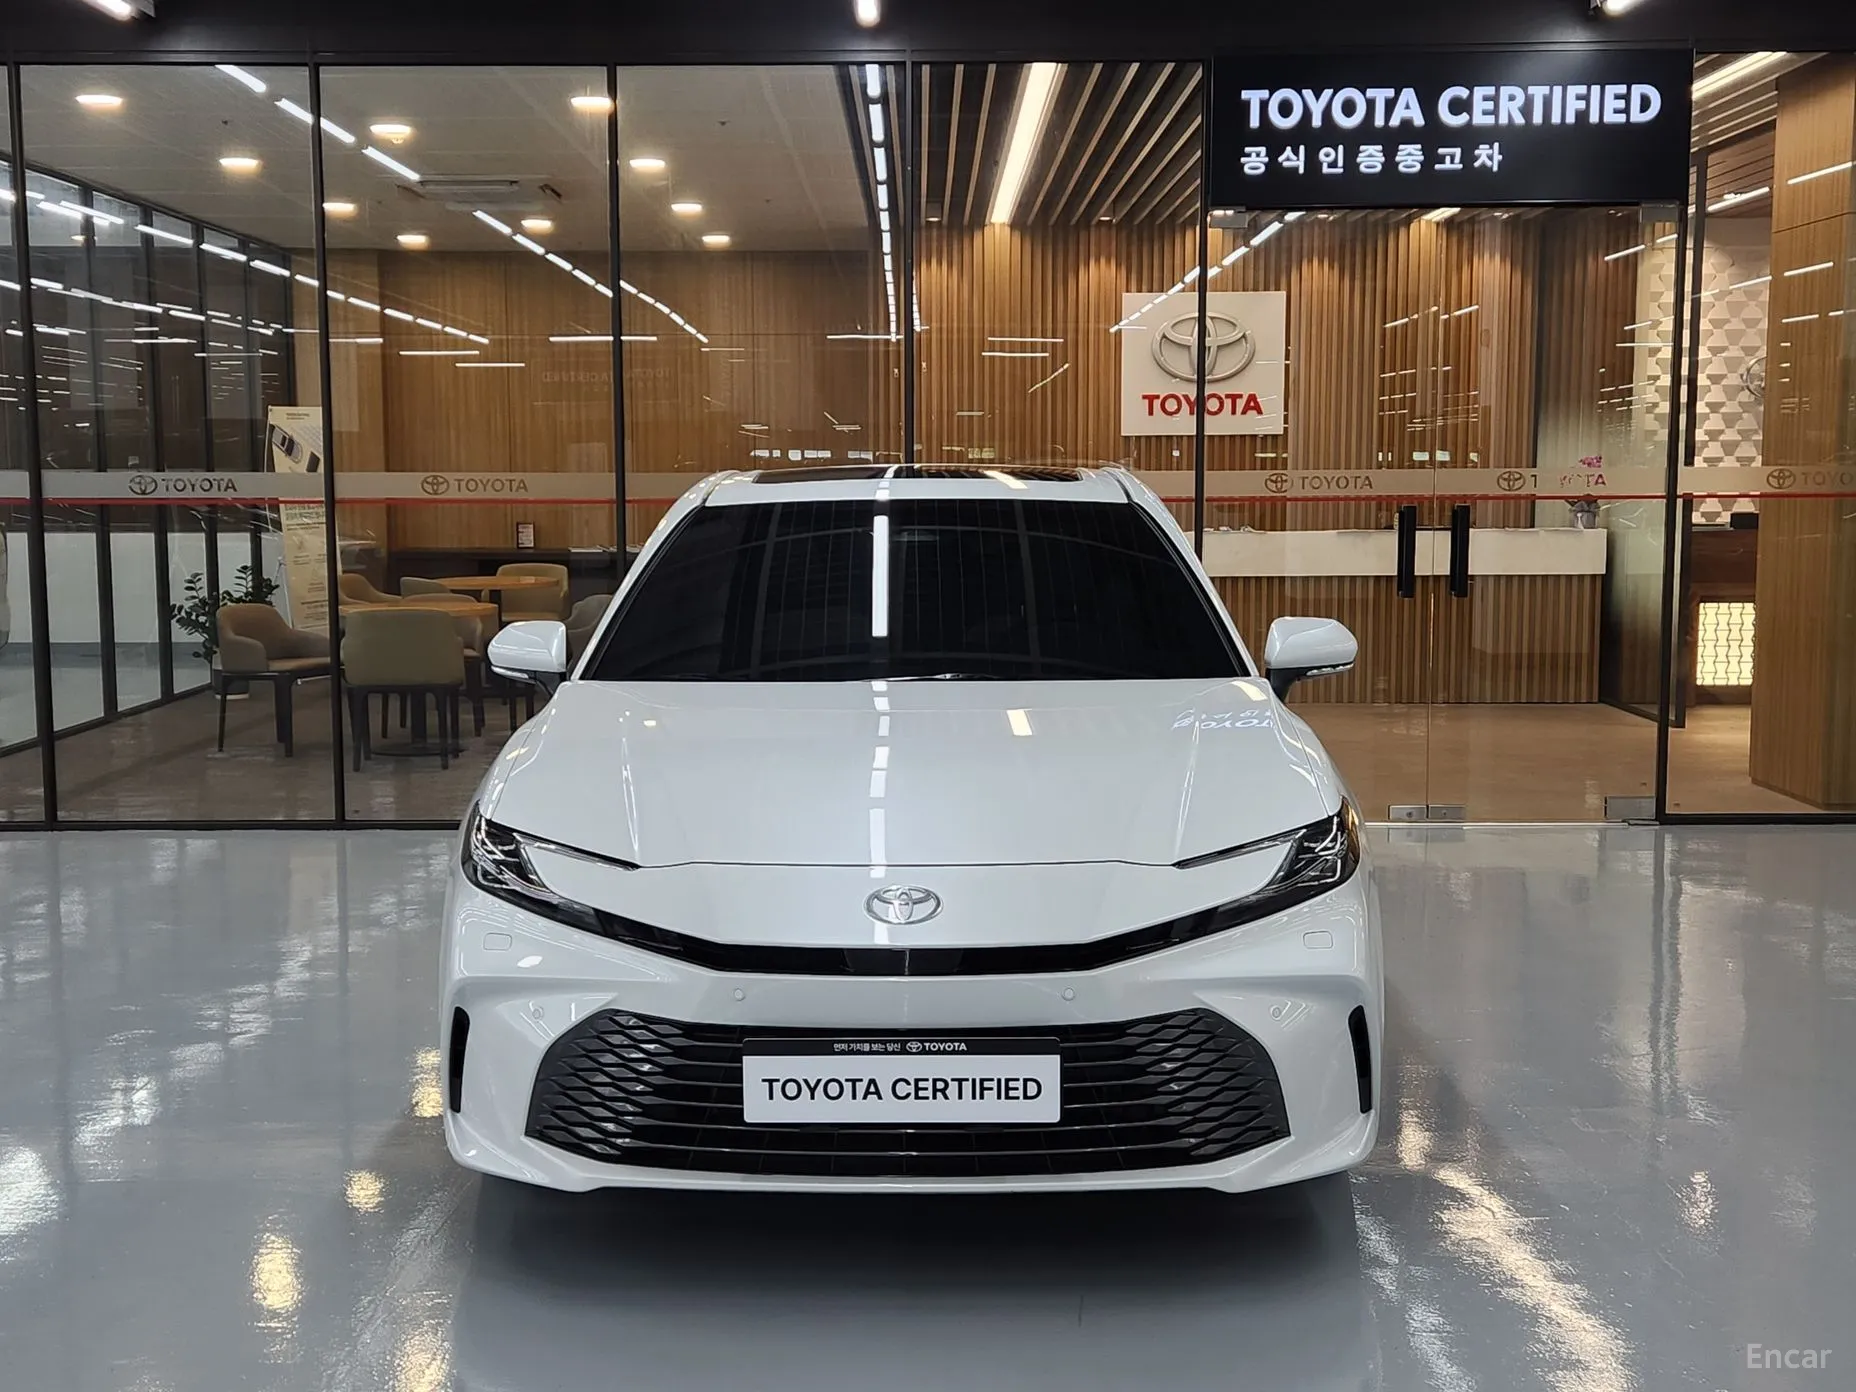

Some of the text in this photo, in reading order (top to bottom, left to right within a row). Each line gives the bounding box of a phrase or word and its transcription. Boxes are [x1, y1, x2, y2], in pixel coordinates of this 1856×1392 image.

[1240, 83, 1662, 129] TOYOTA CERTIFIED
[1141, 393, 1263, 416] TOYOTA
[161, 477, 238, 493] TOYOTA
[453, 477, 529, 493] TOYOTA
[1298, 475, 1373, 490] TOYOTA
[871, 1043, 886, 1052] 보는
[886, 1043, 901, 1052] 당신
[923, 1042, 968, 1051] TOYOTA
[761, 1077, 1043, 1101] TOYOTA CERTIFIED
